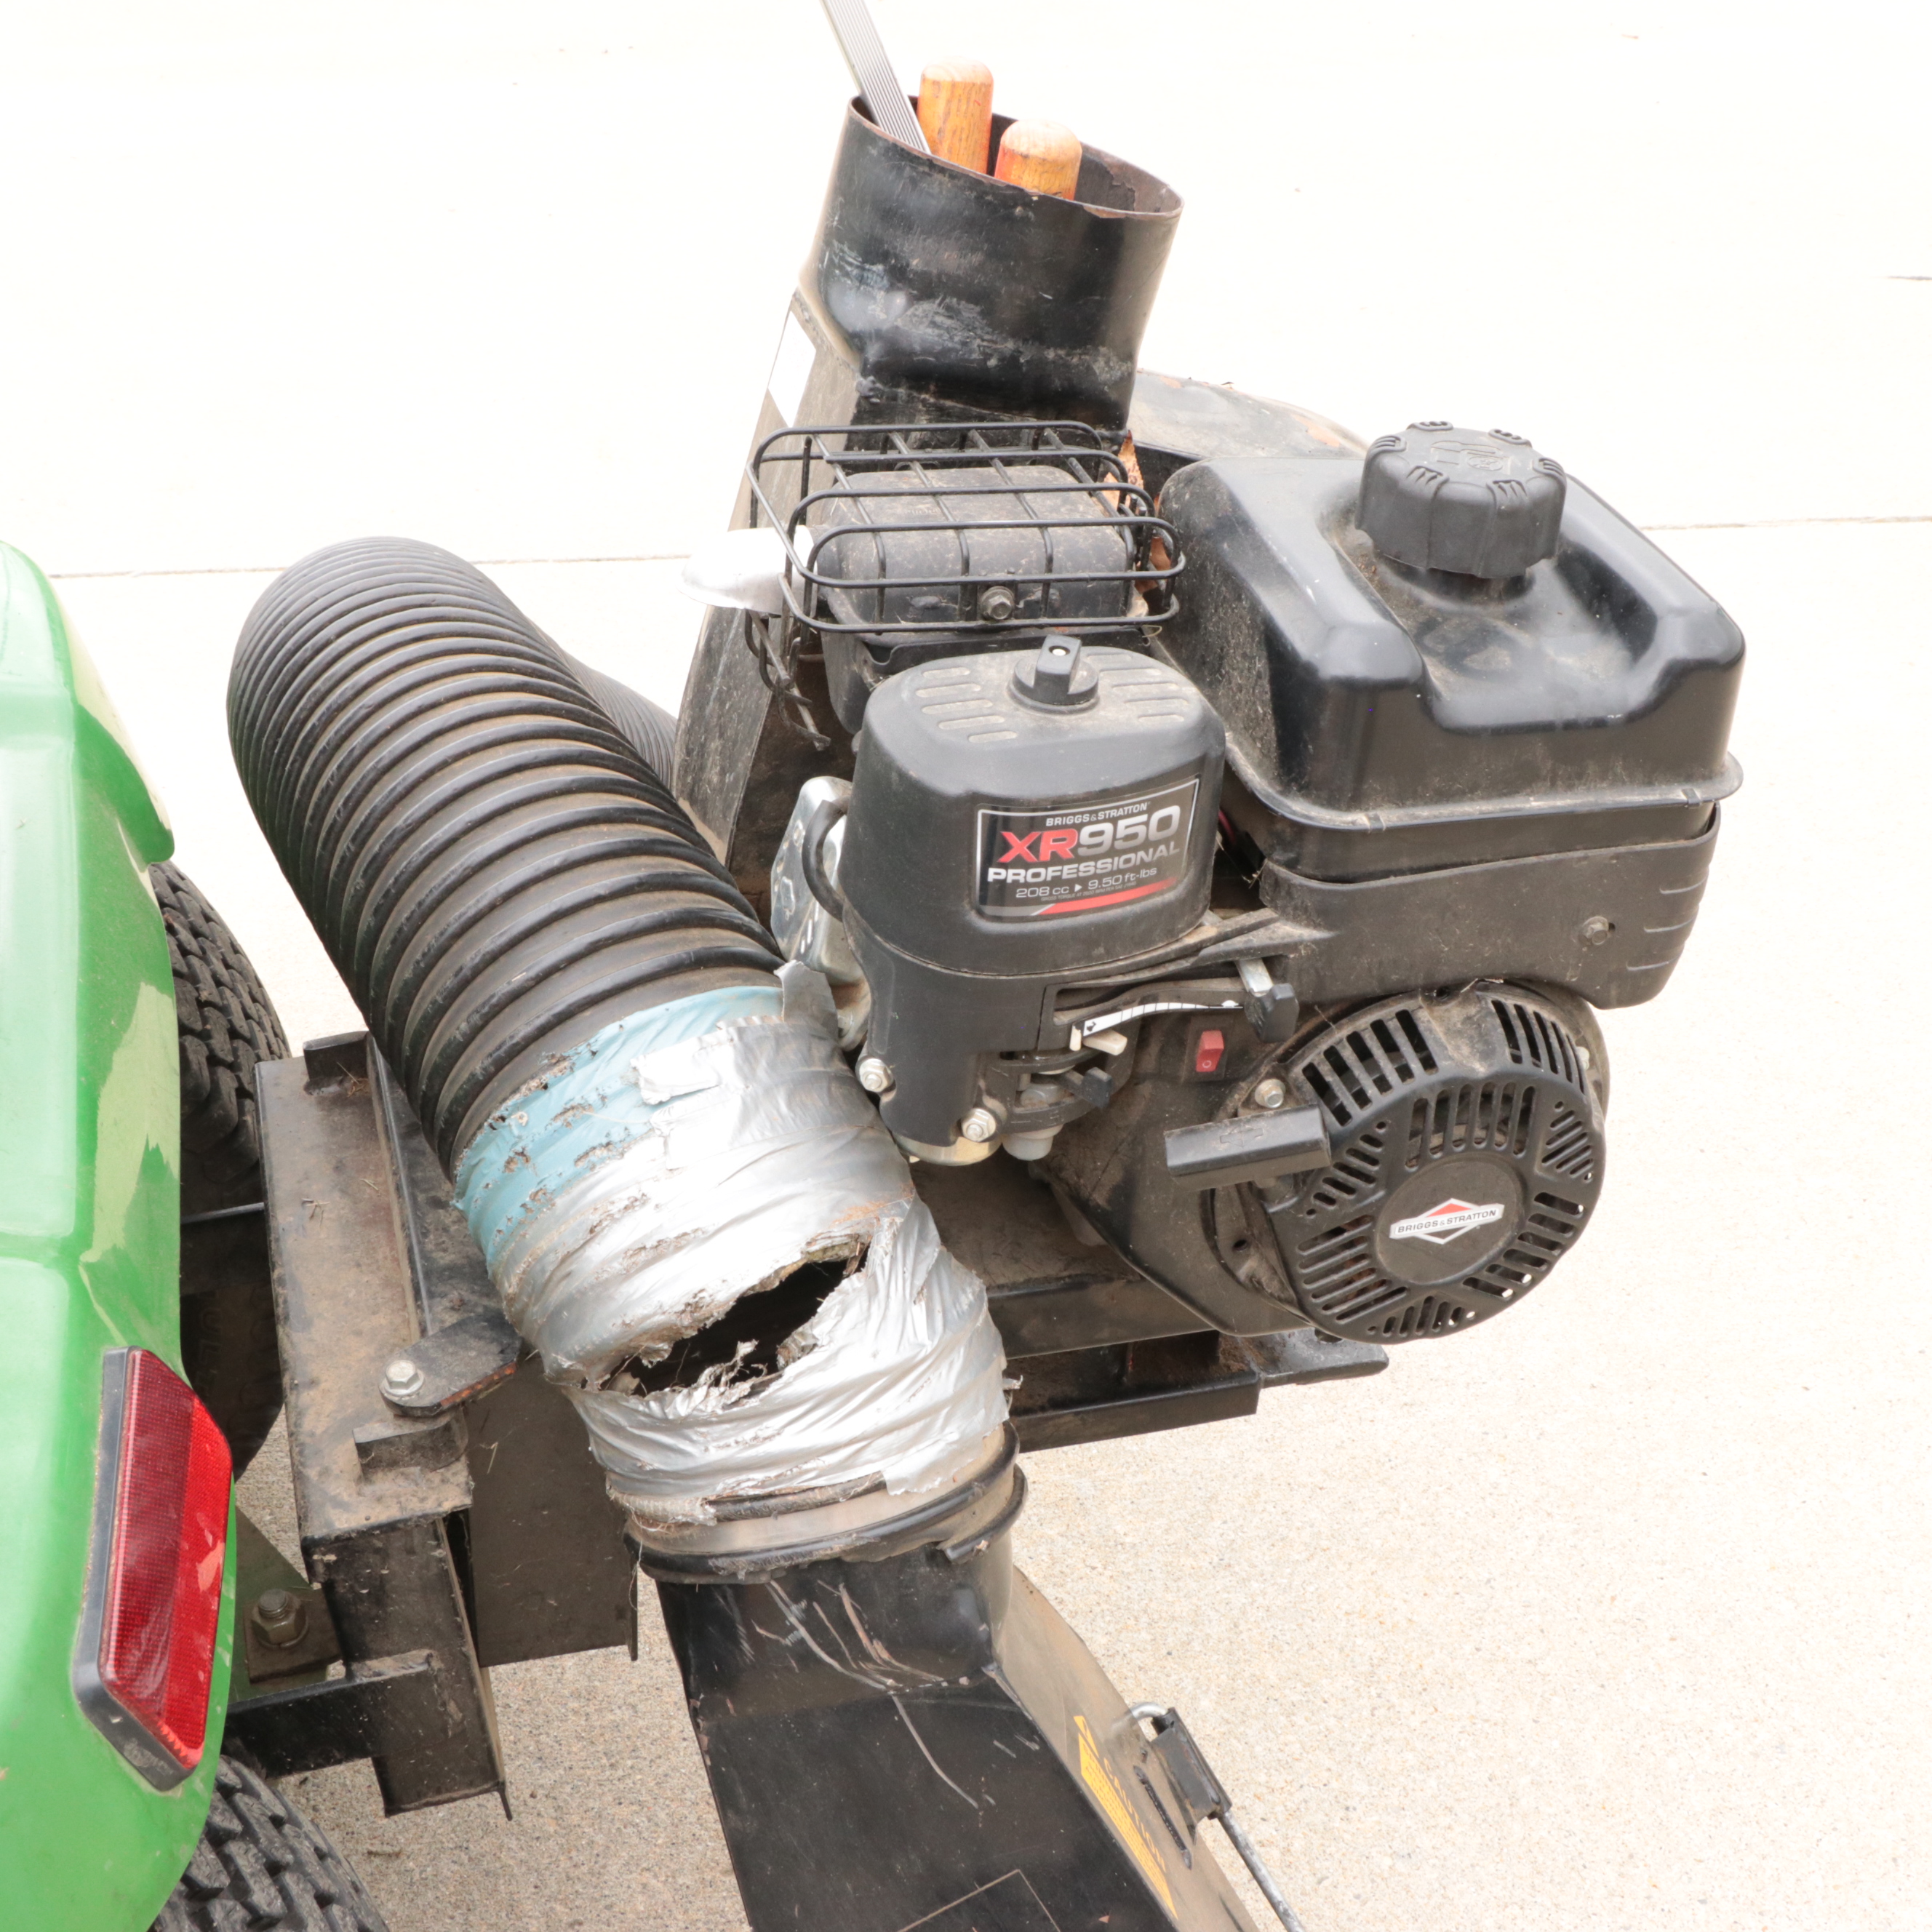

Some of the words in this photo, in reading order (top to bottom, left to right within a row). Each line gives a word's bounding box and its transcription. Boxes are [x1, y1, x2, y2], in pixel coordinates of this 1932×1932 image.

[997, 805, 1181, 863] XR950
[987, 841, 1180, 883] PROFESSIONAL
[1015, 886, 1050, 898] 208
[1053, 886, 1069, 895] cc
[1088, 874, 1122, 890] 9.50
[1125, 868, 1157, 882] ft-lbs
[1103, 1757, 1166, 1872] CAUTION
